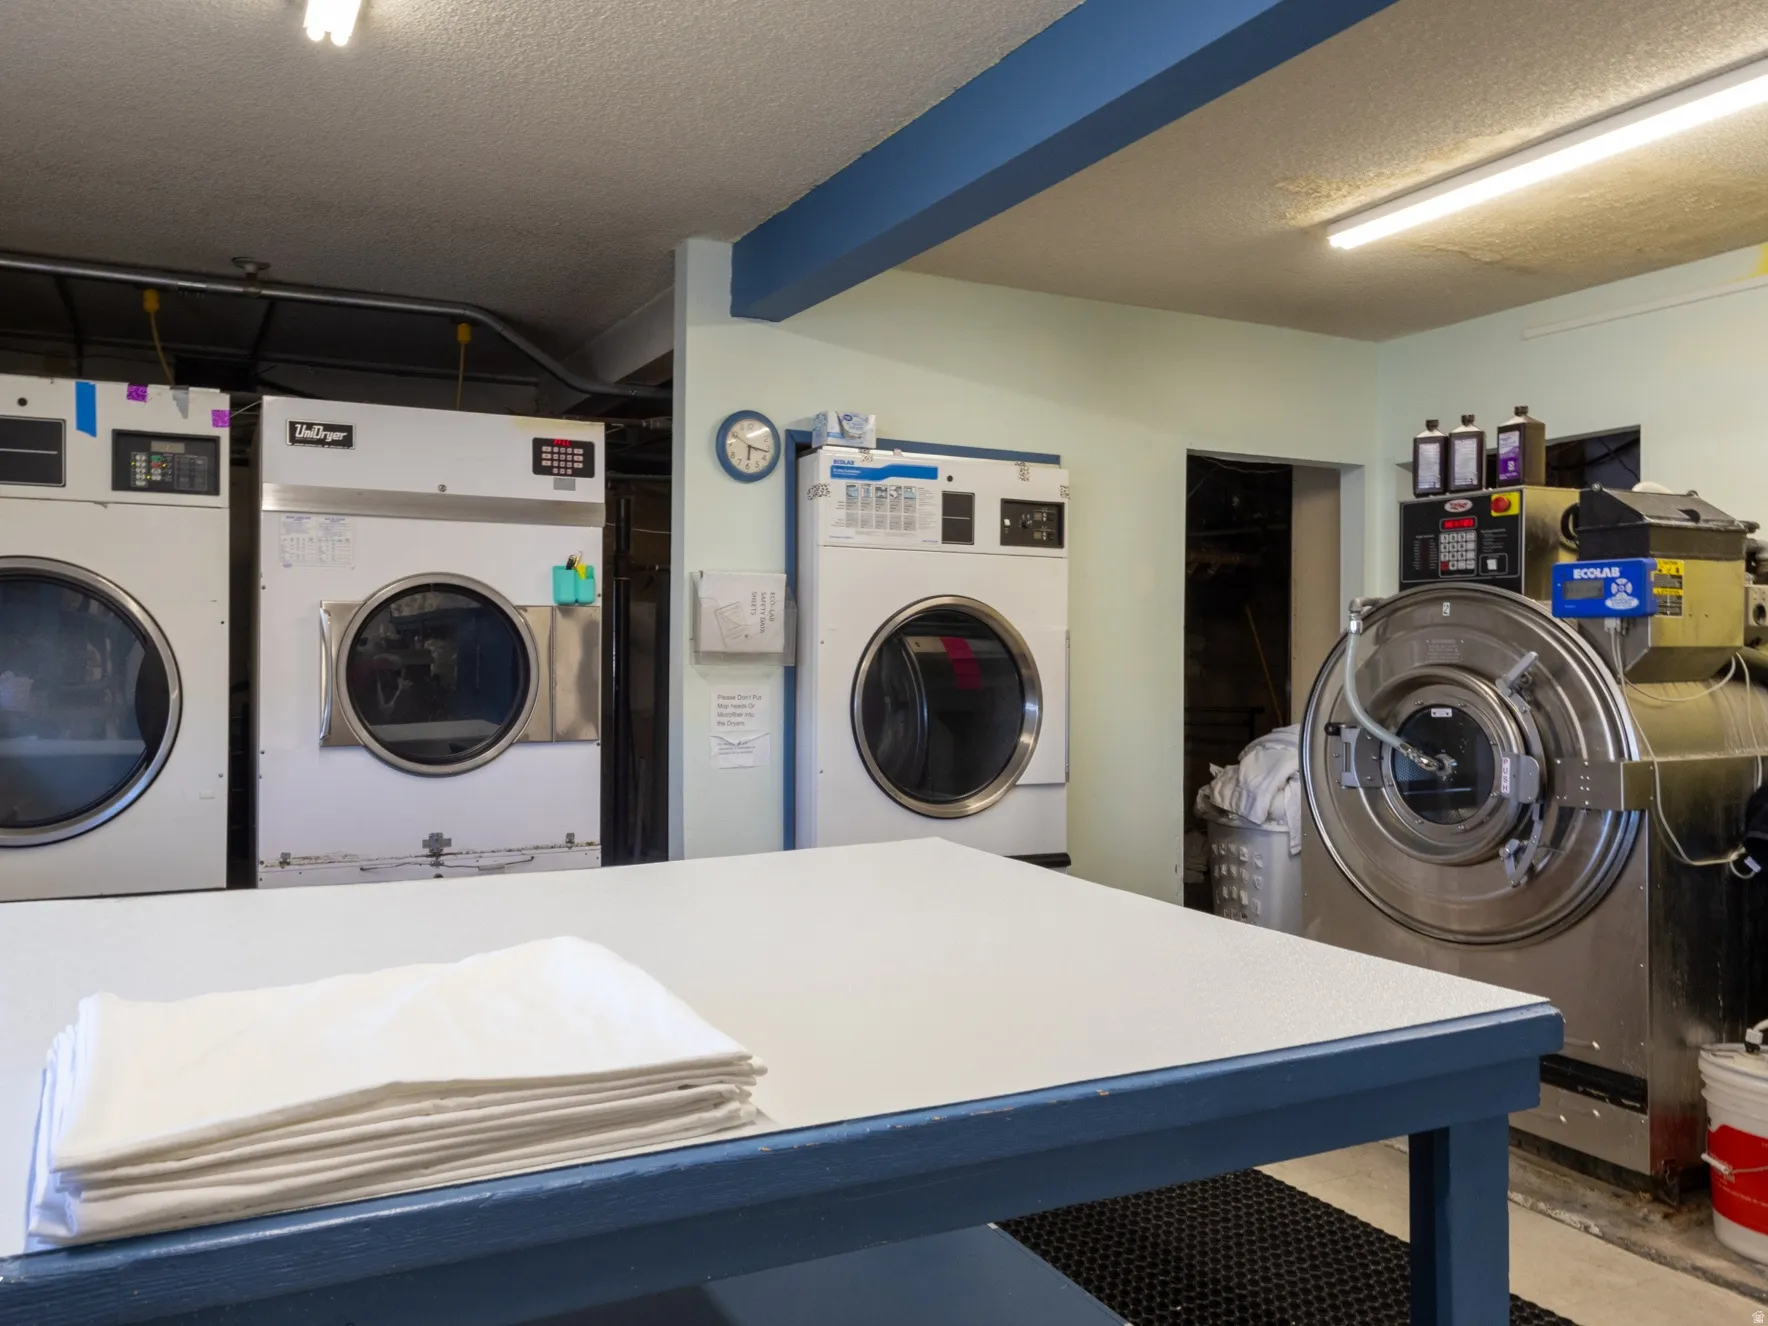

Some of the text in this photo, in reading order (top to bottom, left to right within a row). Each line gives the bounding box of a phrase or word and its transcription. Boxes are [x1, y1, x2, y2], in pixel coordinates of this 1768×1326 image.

[294, 424, 348, 442] UniDryer
[763, 435, 769, 443] 2
[730, 451, 736, 459] 8
[737, 458, 742, 466] 7
[744, 462, 750, 470] 6
[754, 460, 760, 469] 5
[1573, 566, 1620, 579] ECOLAB
[1443, 604, 1449, 614] 2
[726, 720, 745, 728] Dryers
